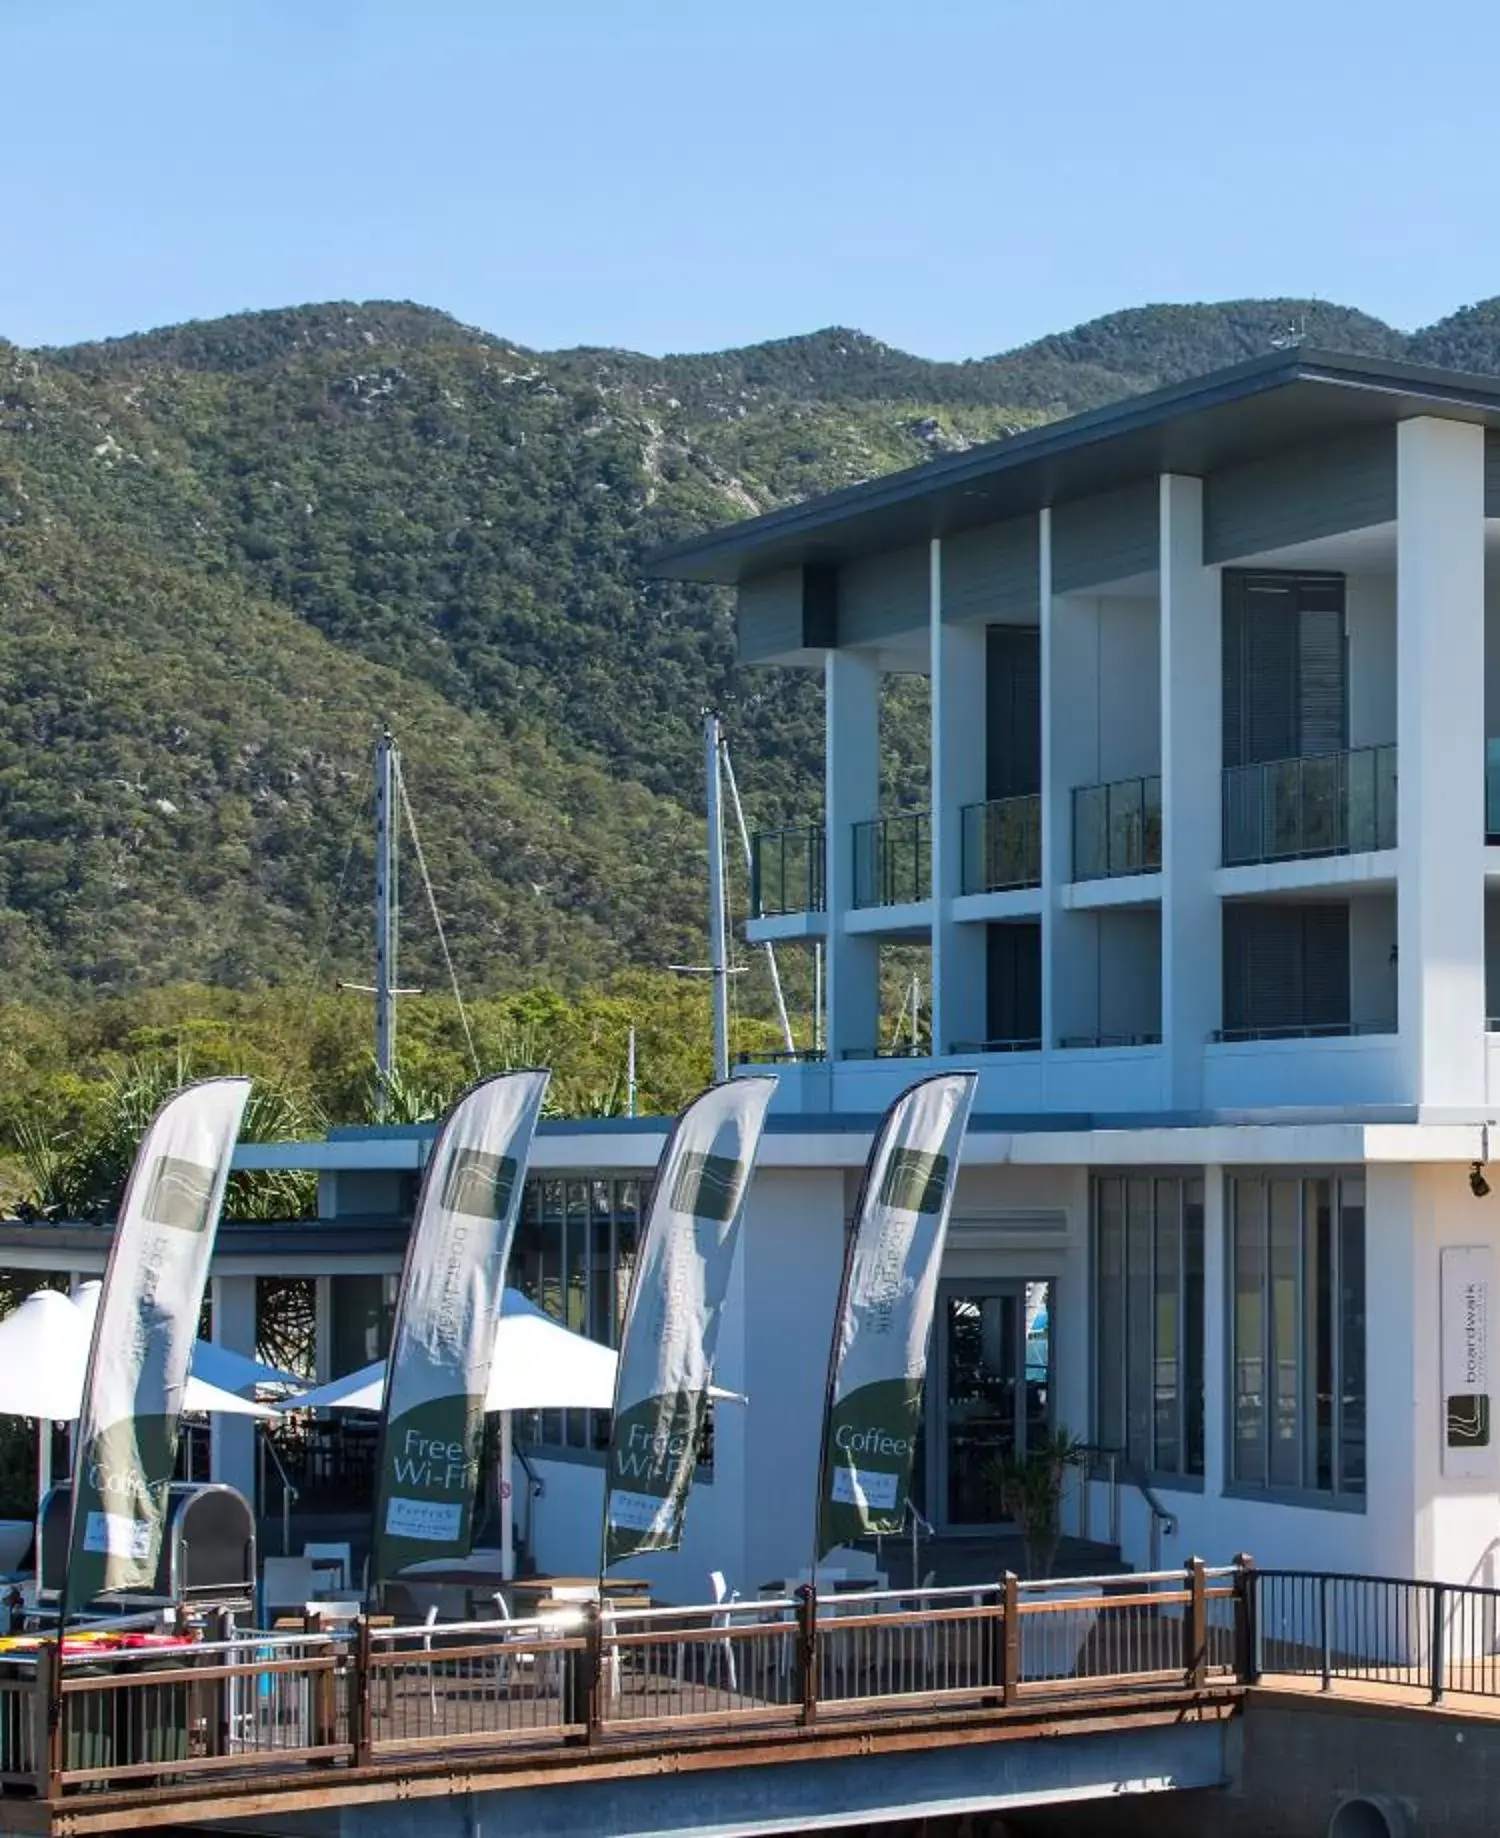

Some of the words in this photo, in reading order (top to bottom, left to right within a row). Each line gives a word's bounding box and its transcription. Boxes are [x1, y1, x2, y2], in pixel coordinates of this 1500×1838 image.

[1464, 1282, 1475, 1384] boardwalk
[405, 1429, 464, 1461] Free
[628, 1423, 685, 1456] Free
[835, 1424, 907, 1456] Coffee
[393, 1456, 467, 1489] Wi-Fi
[617, 1450, 686, 1484] Wi-F
